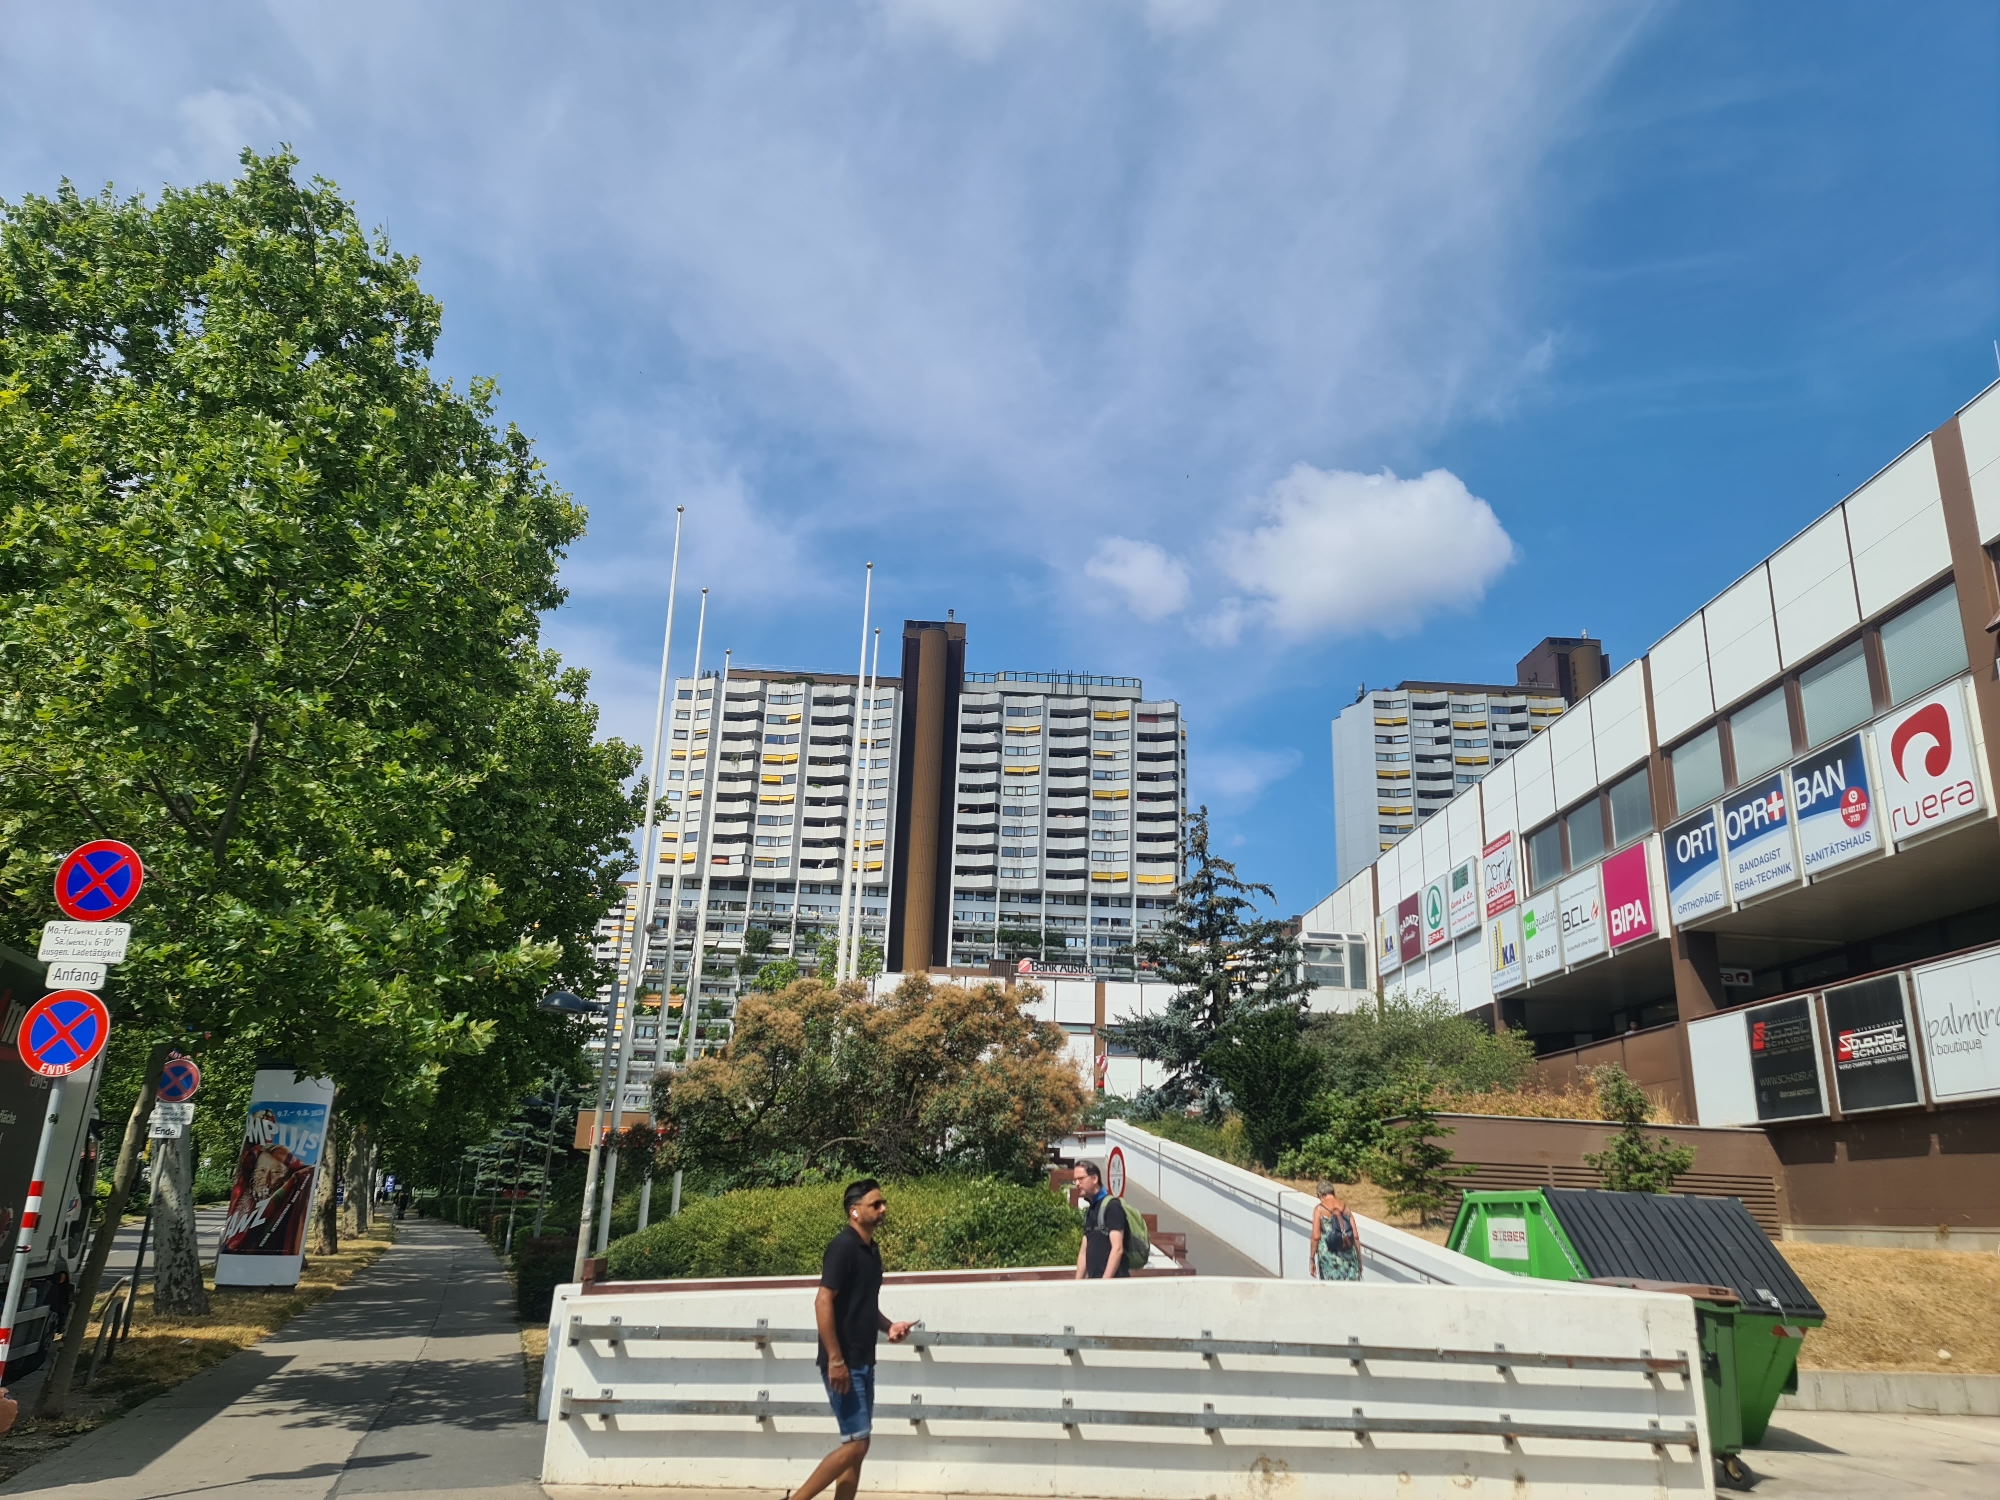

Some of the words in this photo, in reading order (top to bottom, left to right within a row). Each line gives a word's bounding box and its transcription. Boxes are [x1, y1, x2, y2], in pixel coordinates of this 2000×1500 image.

[1892, 780, 1975, 832] ruefa
[1805, 831, 1872, 865] SANITÄTSHAUS
[1739, 848, 1781, 874] BANDAGIST
[1734, 862, 1792, 893] REHA-TECHNIK
[1678, 890, 1723, 915] ORTHOPÄDIE-
[1562, 905, 1589, 932] BCL
[1610, 899, 1647, 937] BIPA
[54, 937, 66, 946] Sa.
[1428, 929, 1444, 945] SPAR
[41, 949, 69, 958] ausgen.
[72, 949, 122, 959] Ladetätigkeit
[53, 967, 99, 985] Anfang
[1032, 961, 1057, 972] Bank
[1060, 962, 1094, 974] Austria
[1765, 1034, 1811, 1048] SCHAIDER
[1852, 1041, 1906, 1058] SCHAIDER
[1935, 1038, 1982, 1056] boutique
[39, 1062, 72, 1076] ENDE
[155, 1127, 175, 1136] Ende
